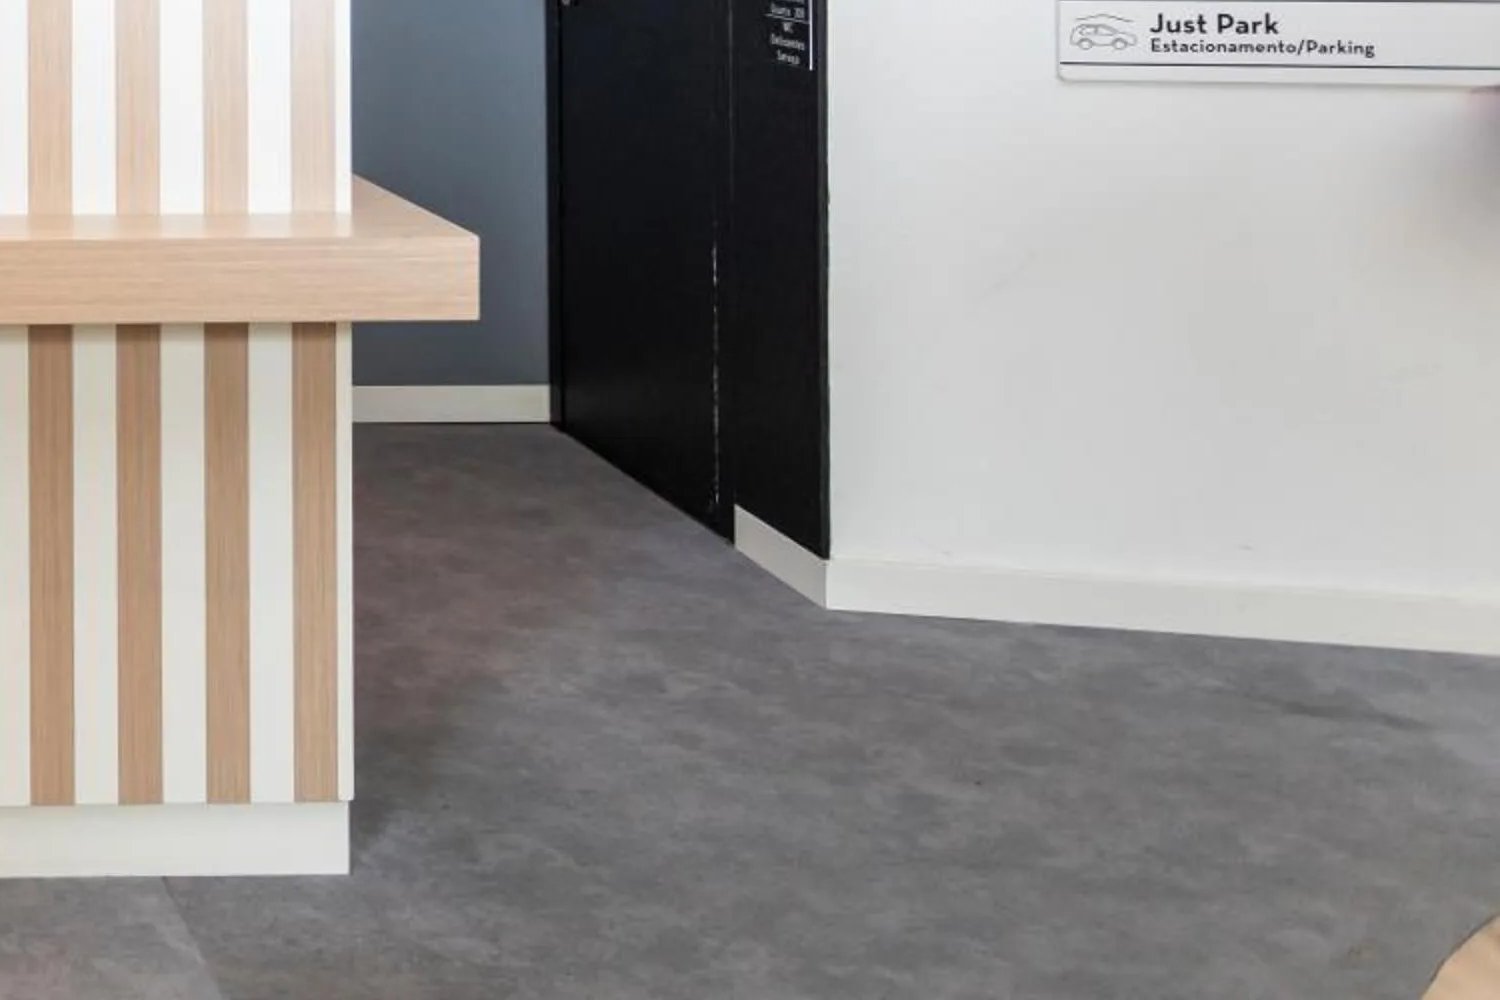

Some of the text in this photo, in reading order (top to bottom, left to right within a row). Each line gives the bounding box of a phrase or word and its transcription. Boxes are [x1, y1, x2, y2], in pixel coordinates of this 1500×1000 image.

[1150, 12, 1280, 35] Just Park
[1151, 38, 1376, 58] Estacionamento/Parking
